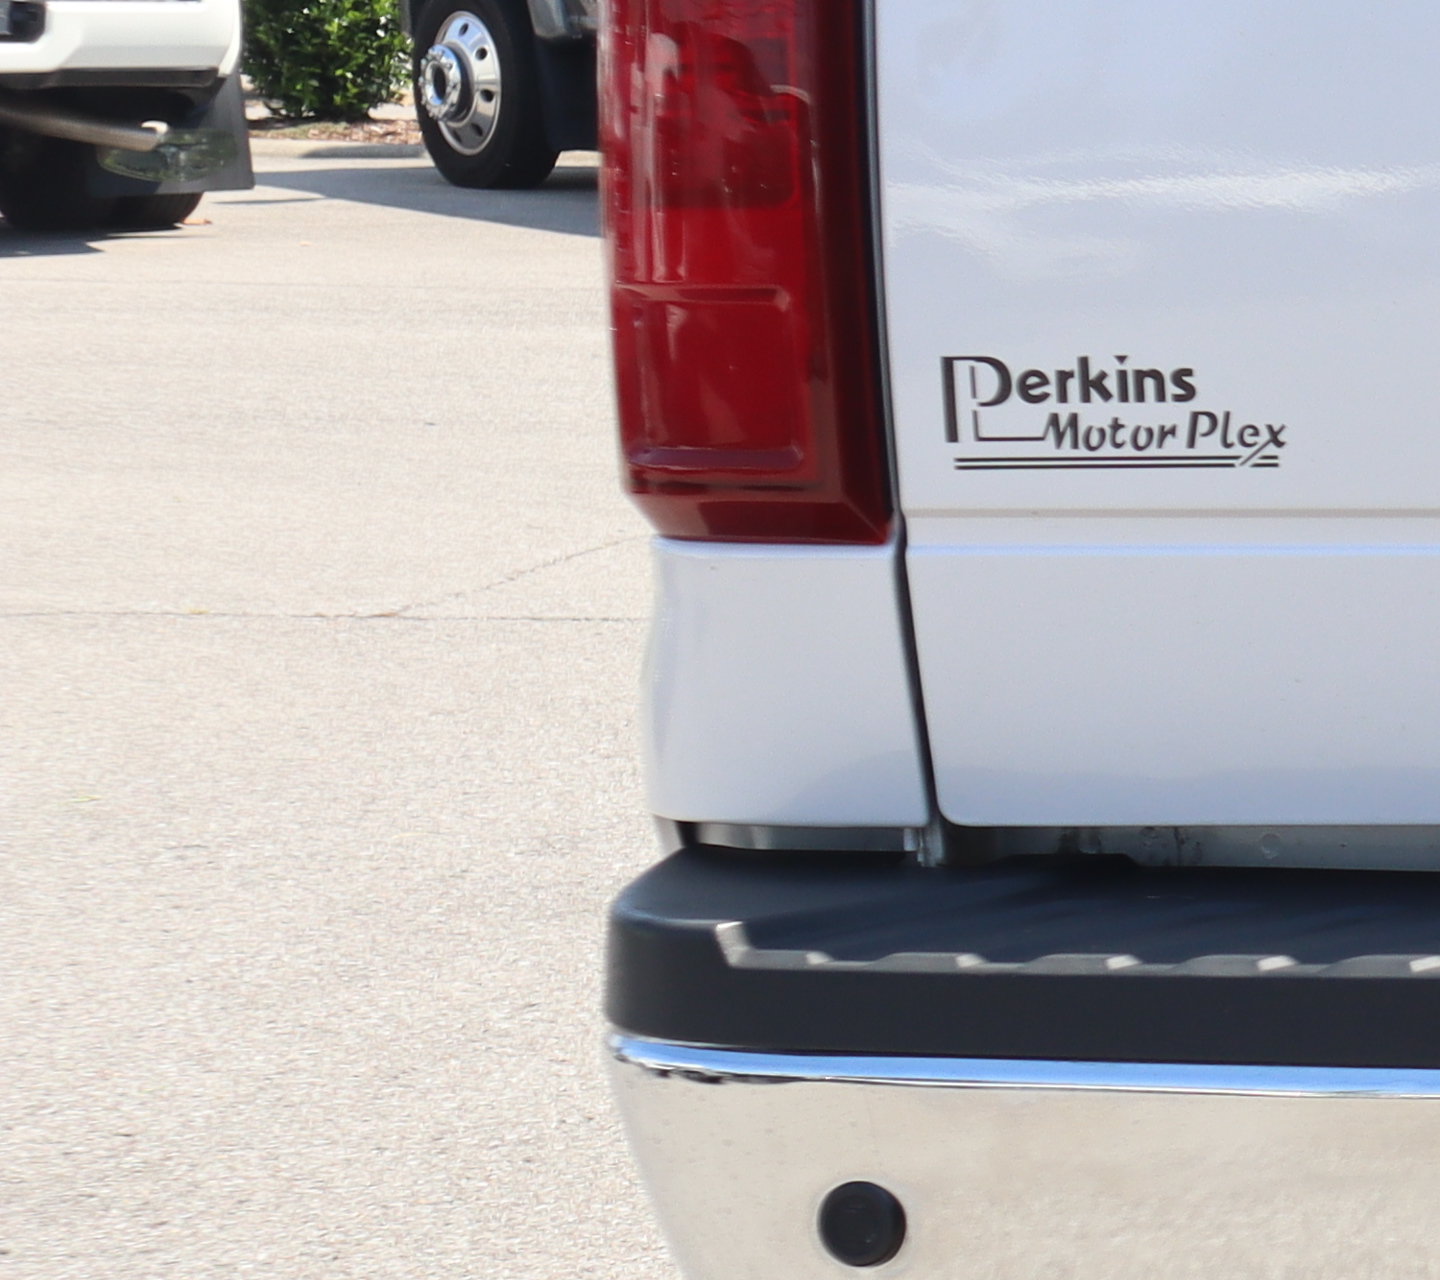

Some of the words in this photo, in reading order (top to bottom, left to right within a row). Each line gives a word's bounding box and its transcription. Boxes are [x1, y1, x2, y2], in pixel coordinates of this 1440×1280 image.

[940, 355, 1198, 443] Perkins
[1046, 412, 1178, 452] Motor
[1185, 410, 1287, 466] Plex
